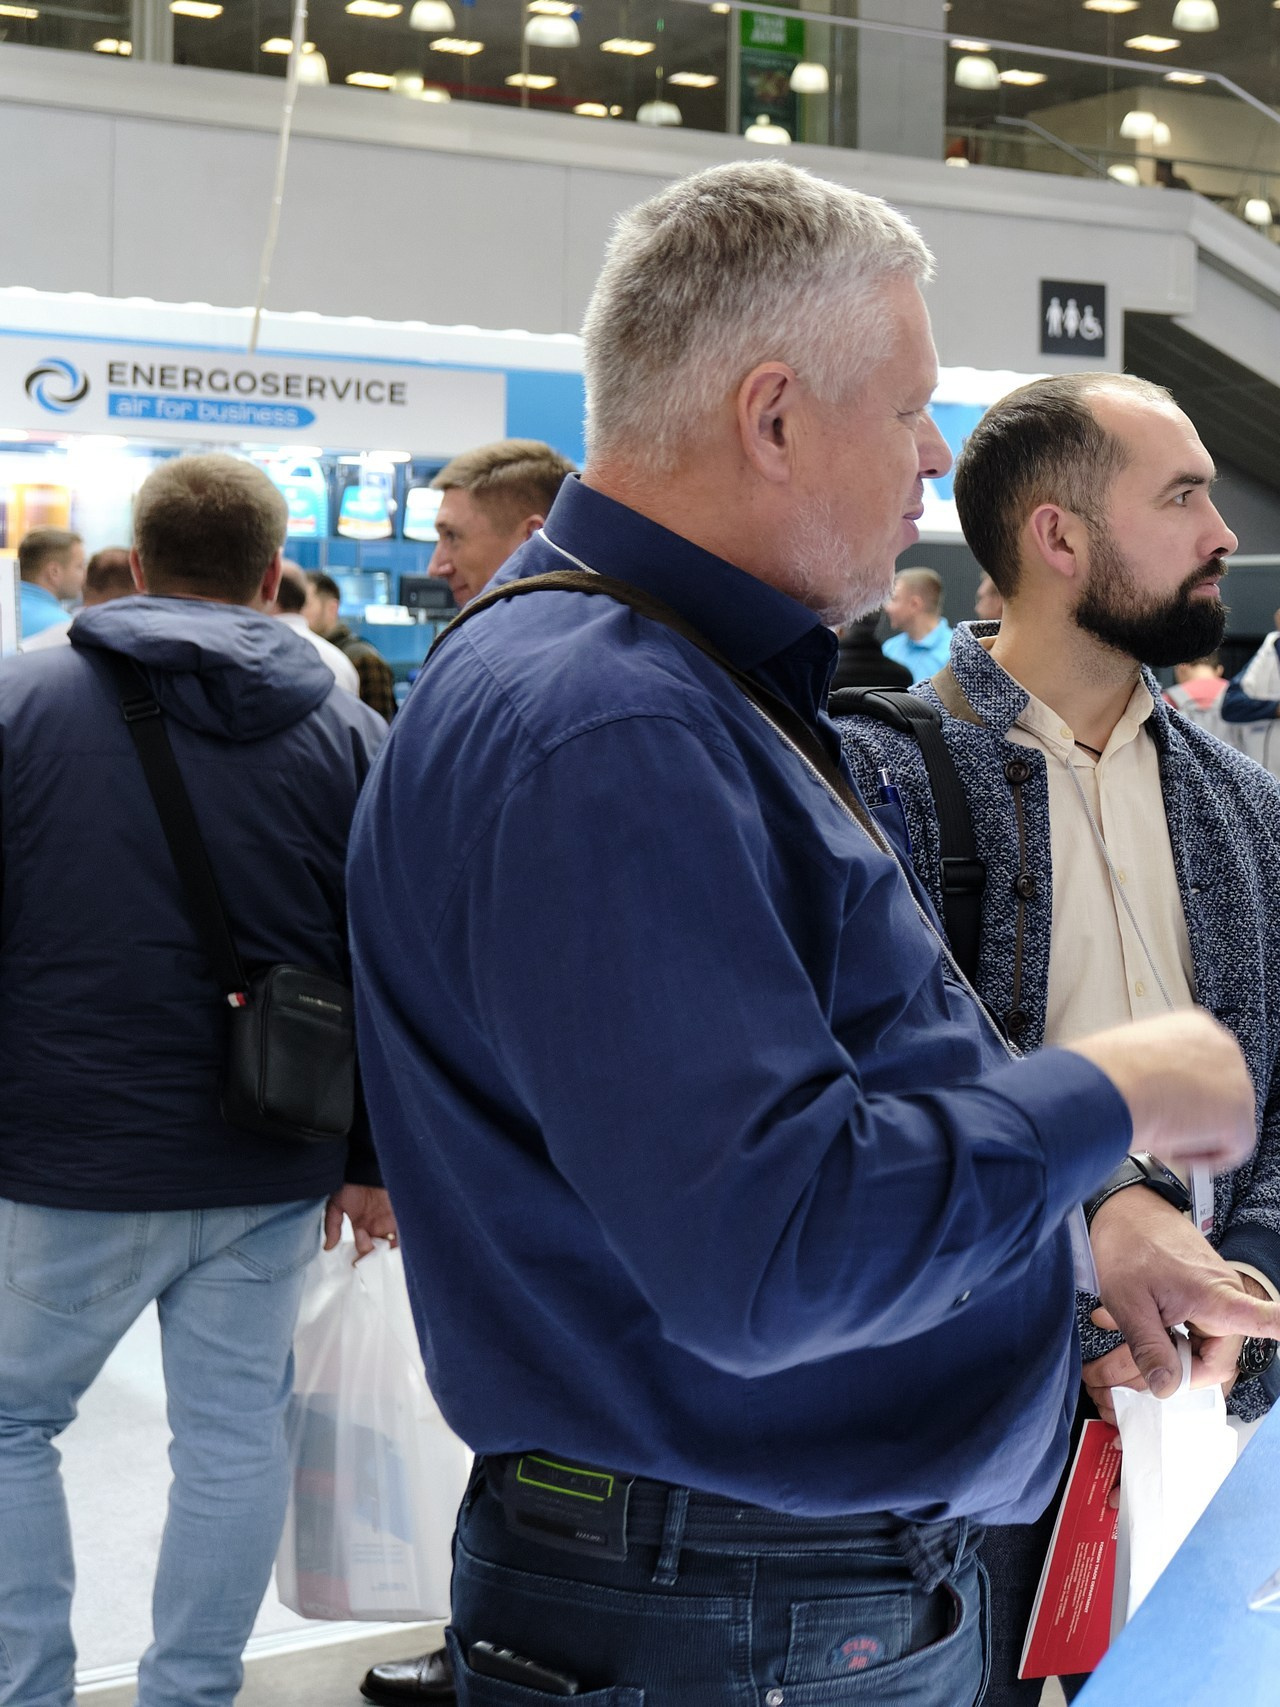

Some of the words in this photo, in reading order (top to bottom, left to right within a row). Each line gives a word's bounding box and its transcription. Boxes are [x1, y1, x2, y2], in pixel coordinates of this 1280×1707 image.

[107, 361, 408, 405] ENERGOSERVICE
[116, 396, 147, 417] air
[155, 398, 194, 420] for
[198, 402, 299, 427] business
